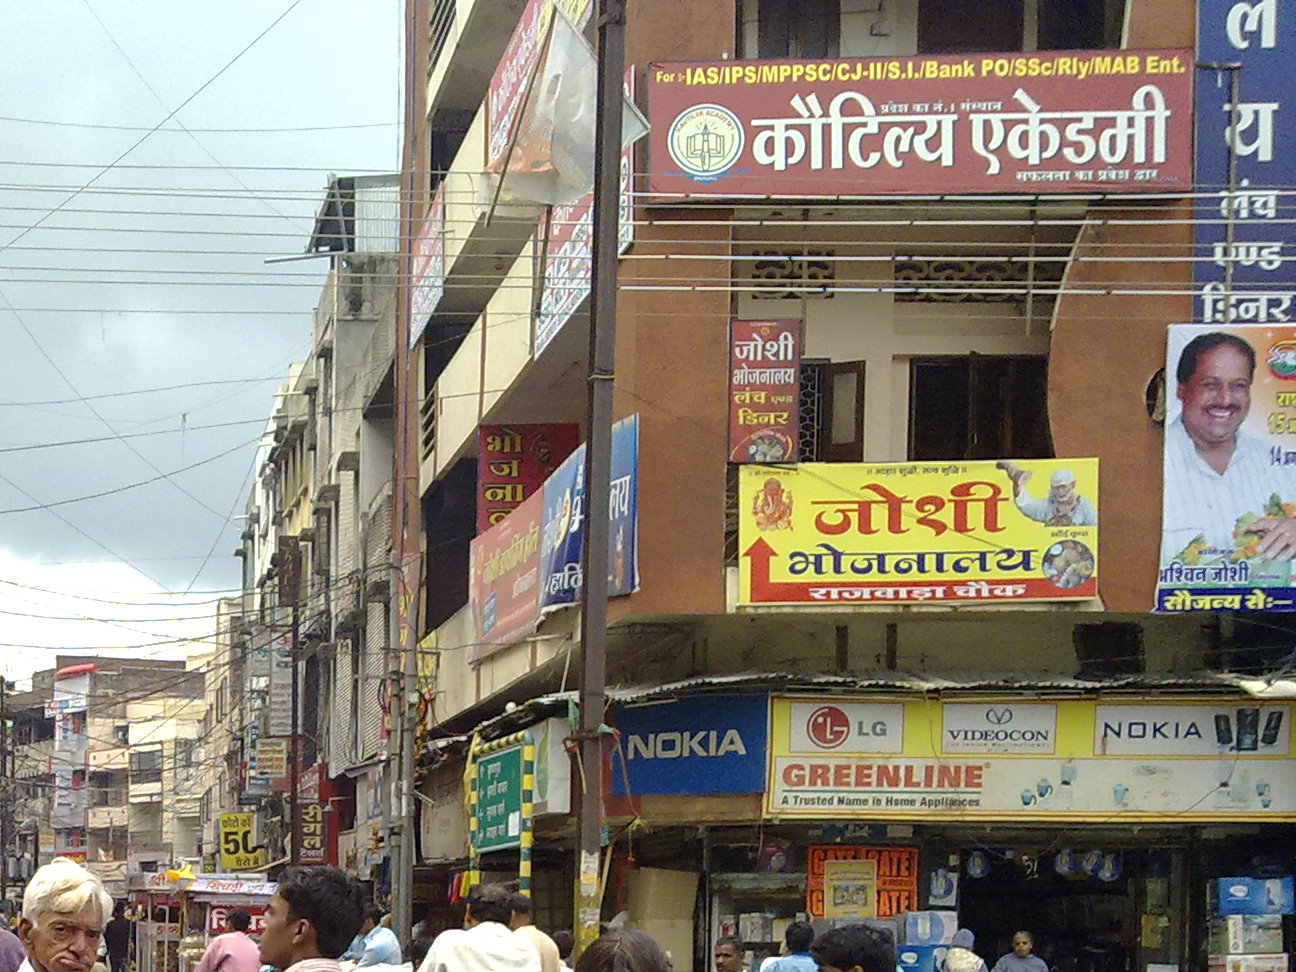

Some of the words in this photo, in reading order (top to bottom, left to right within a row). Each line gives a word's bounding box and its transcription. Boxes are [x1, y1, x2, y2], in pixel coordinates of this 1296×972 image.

[656, 71, 675, 83] For
[1146, 56, 1186, 74] Ent.
[751, 91, 958, 171] कौटिल्य
[969, 85, 1171, 175] एकेडमी
[735, 331, 795, 361] जोशी
[733, 363, 795, 385] भोजनालय
[734, 386, 768, 404] लंच
[738, 408, 789, 424] डिनर
[811, 481, 1009, 536] जोशी
[788, 543, 1039, 575] भोजनालय
[1211, 559, 1249, 582] जोशी
[808, 585, 945, 601] राजवाड़ा
[953, 582, 1026, 598] चौक
[1164, 588, 1242, 610] सौजन्य
[857, 720, 888, 738] LG
[947, 729, 1049, 741] VIDEOCON
[1104, 721, 1203, 739] NOKIA
[627, 729, 747, 760] NOKIA
[782, 763, 984, 789] GREENLINE
[781, 795, 790, 806] A
[793, 795, 834, 806] Trusted
[837, 796, 869, 806] Name
[872, 796, 882, 806] in
[885, 796, 916, 807] Home
[920, 796, 981, 810] Appliances
